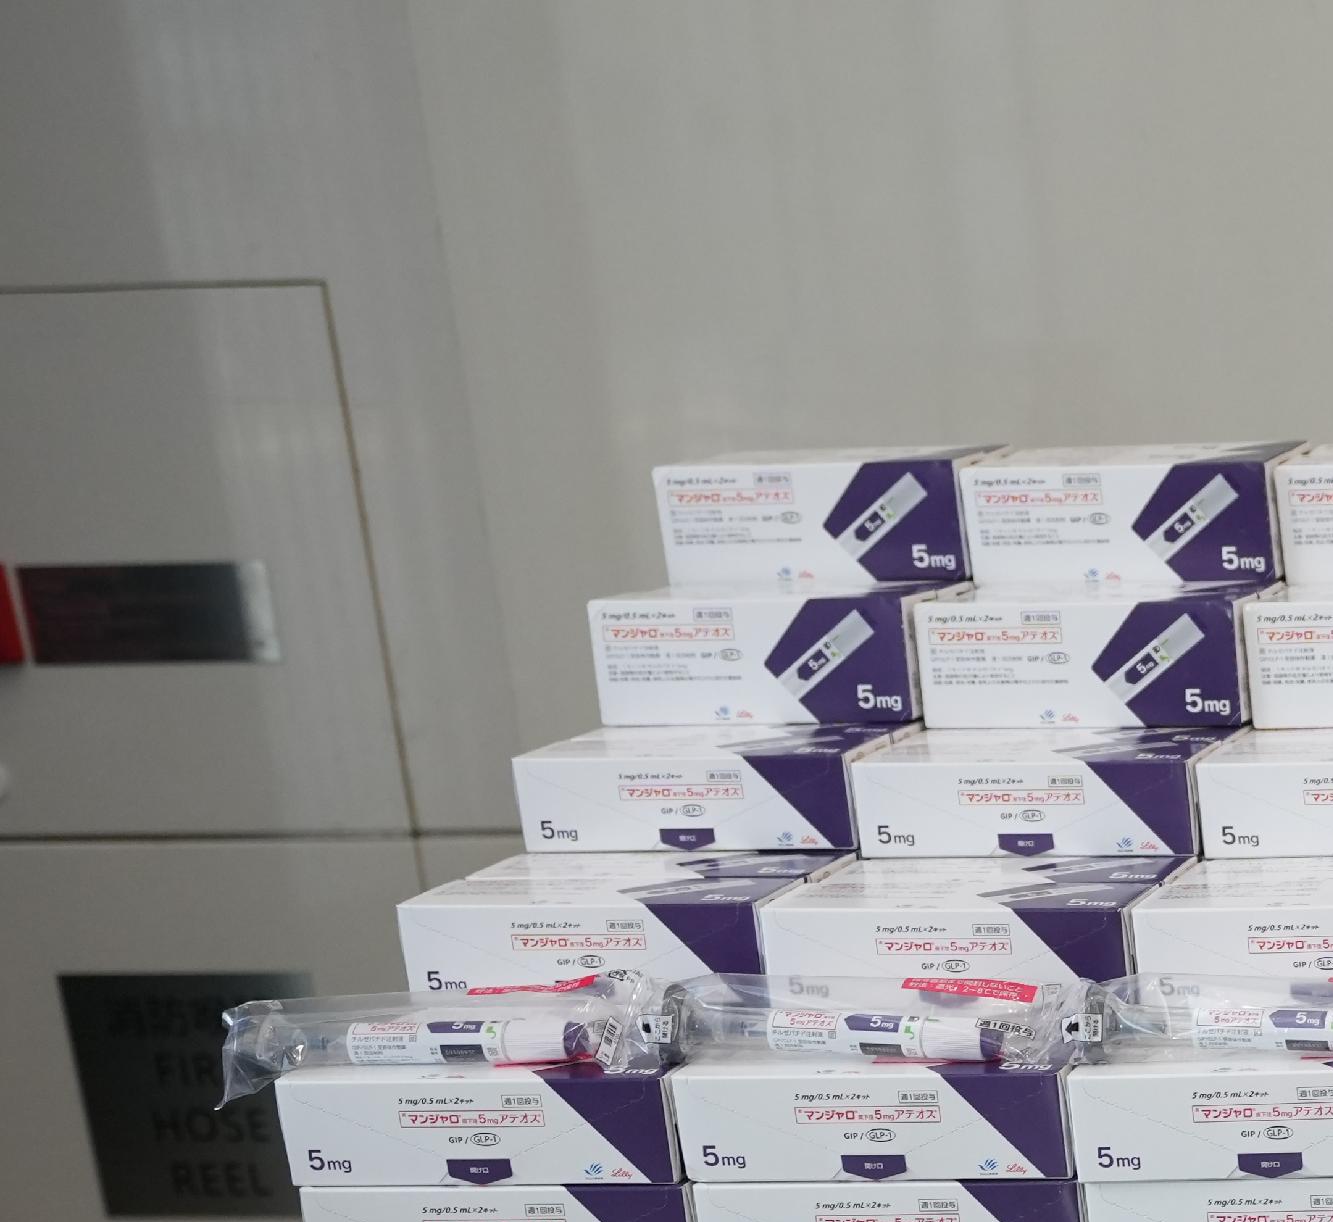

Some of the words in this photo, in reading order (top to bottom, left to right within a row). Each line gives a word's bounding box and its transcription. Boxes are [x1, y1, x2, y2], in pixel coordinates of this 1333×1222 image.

[912, 544, 956, 570] 5mg
[1222, 546, 1265, 572] 5mg
[857, 684, 902, 711] 5mg
[1185, 689, 1231, 715] 5mg
[154, 1053, 224, 1087] FIR
[155, 1107, 270, 1142] HOSE
[172, 1160, 273, 1198] REEL
